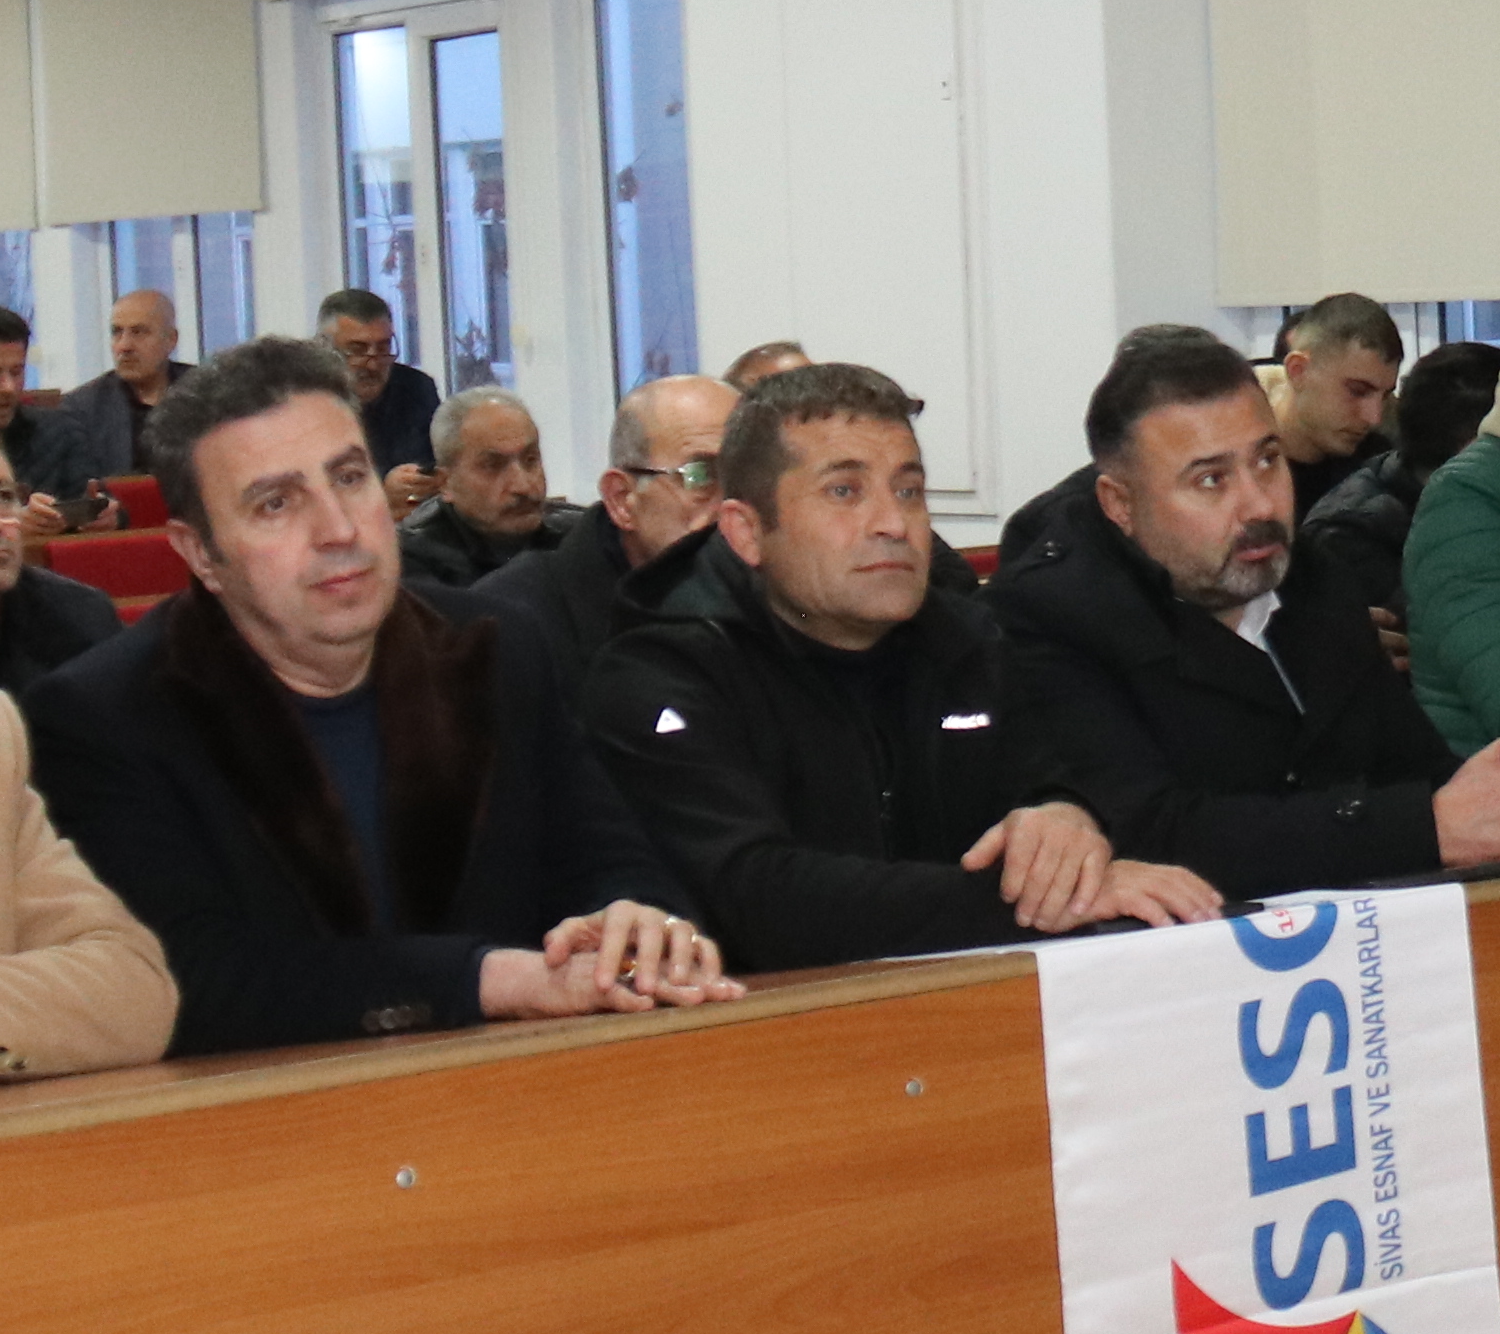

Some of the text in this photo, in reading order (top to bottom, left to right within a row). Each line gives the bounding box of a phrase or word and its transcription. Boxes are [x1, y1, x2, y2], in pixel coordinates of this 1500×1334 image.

[1353, 897, 1403, 1279] SİVAS ESNAF VE SANATKARLAR
